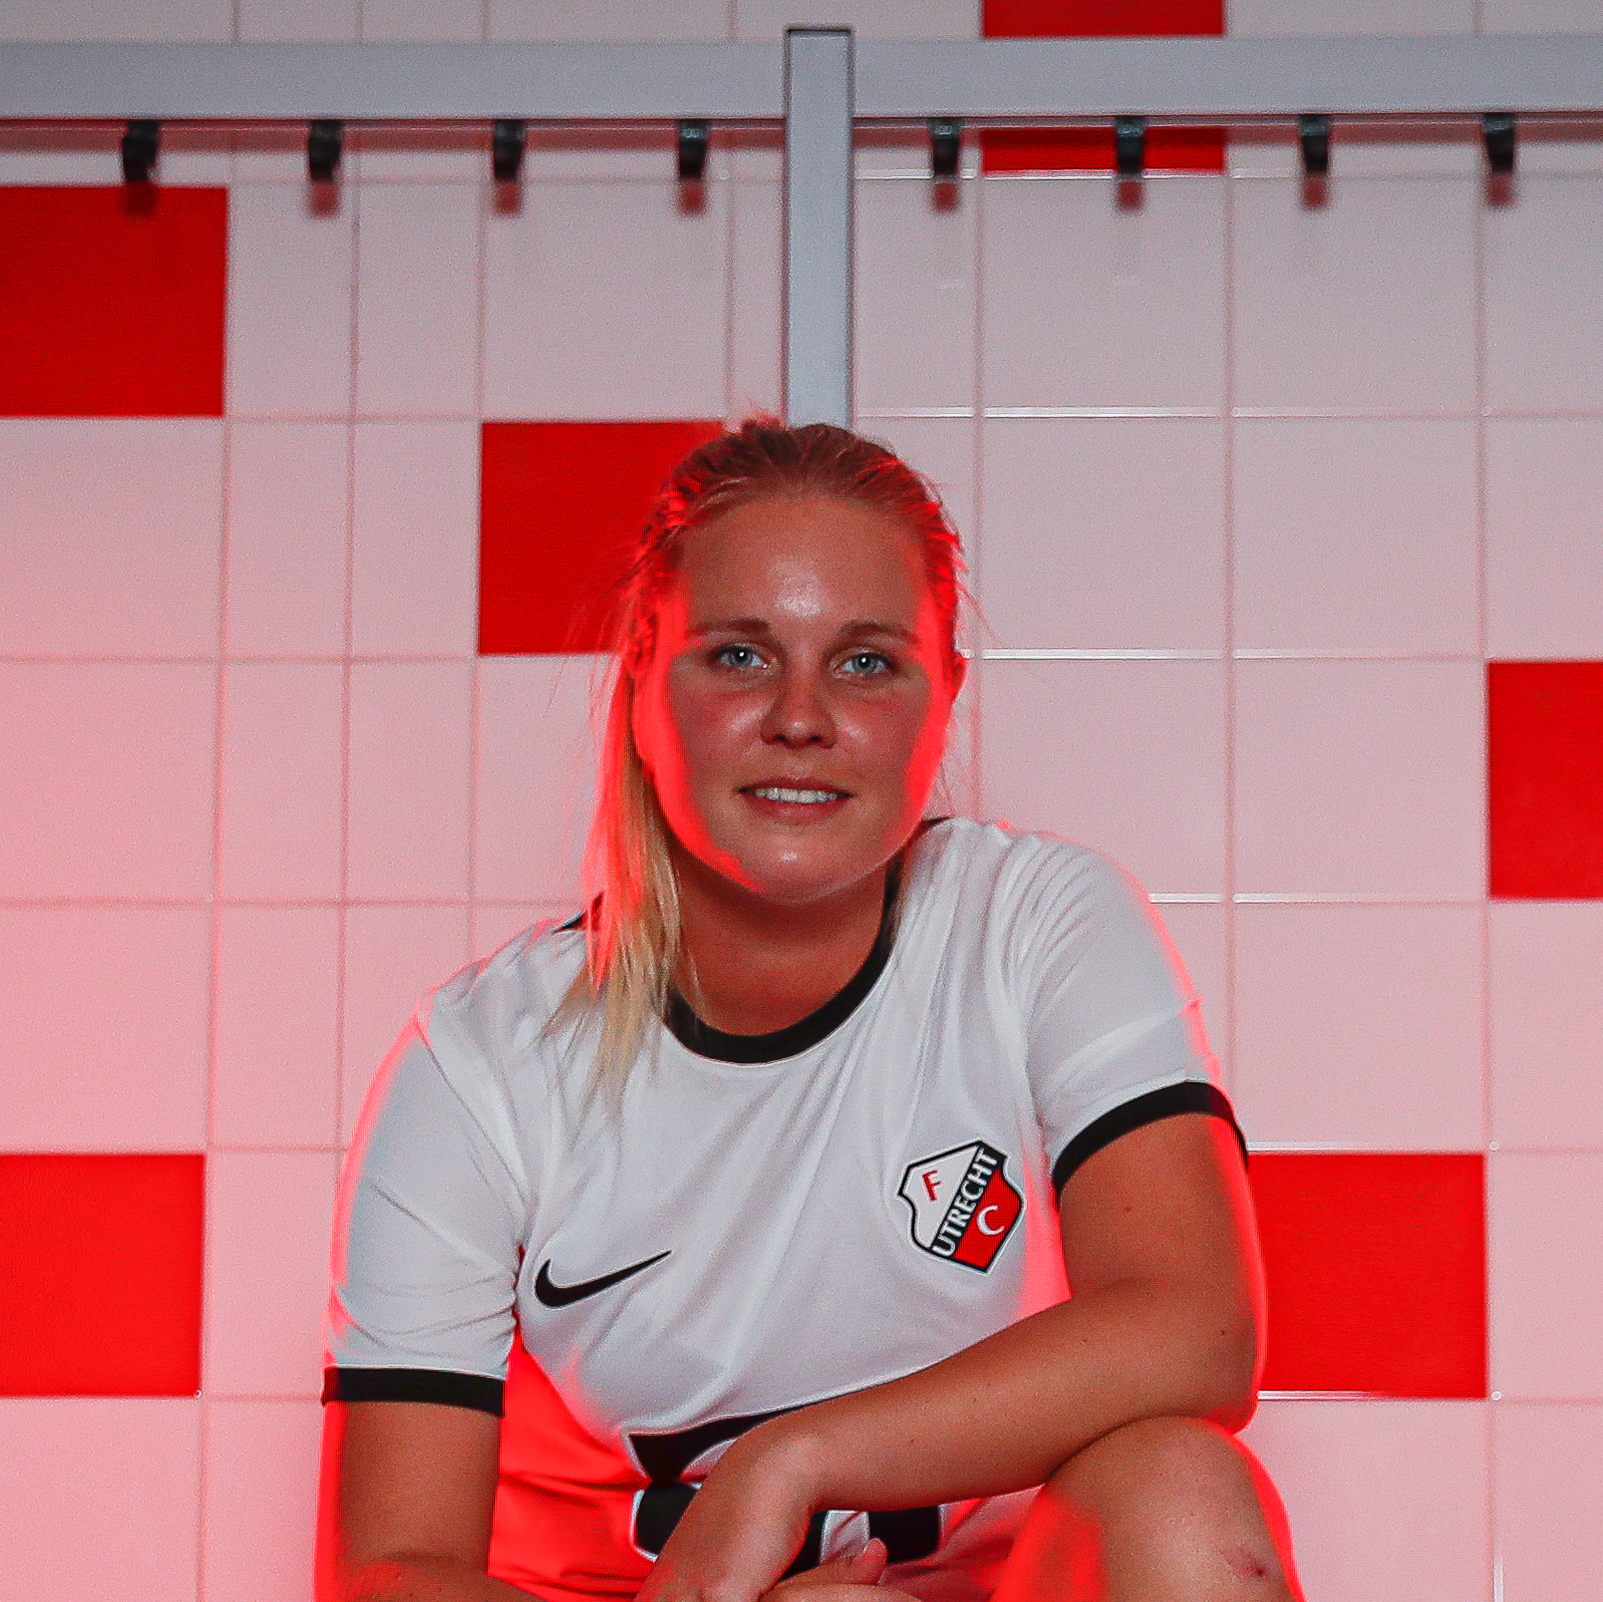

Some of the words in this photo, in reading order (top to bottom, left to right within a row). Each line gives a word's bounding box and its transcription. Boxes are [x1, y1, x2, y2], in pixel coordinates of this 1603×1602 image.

[921, 1169, 943, 1202] F
[931, 1147, 998, 1258] UTRECHT
[976, 1205, 1006, 1237] C
